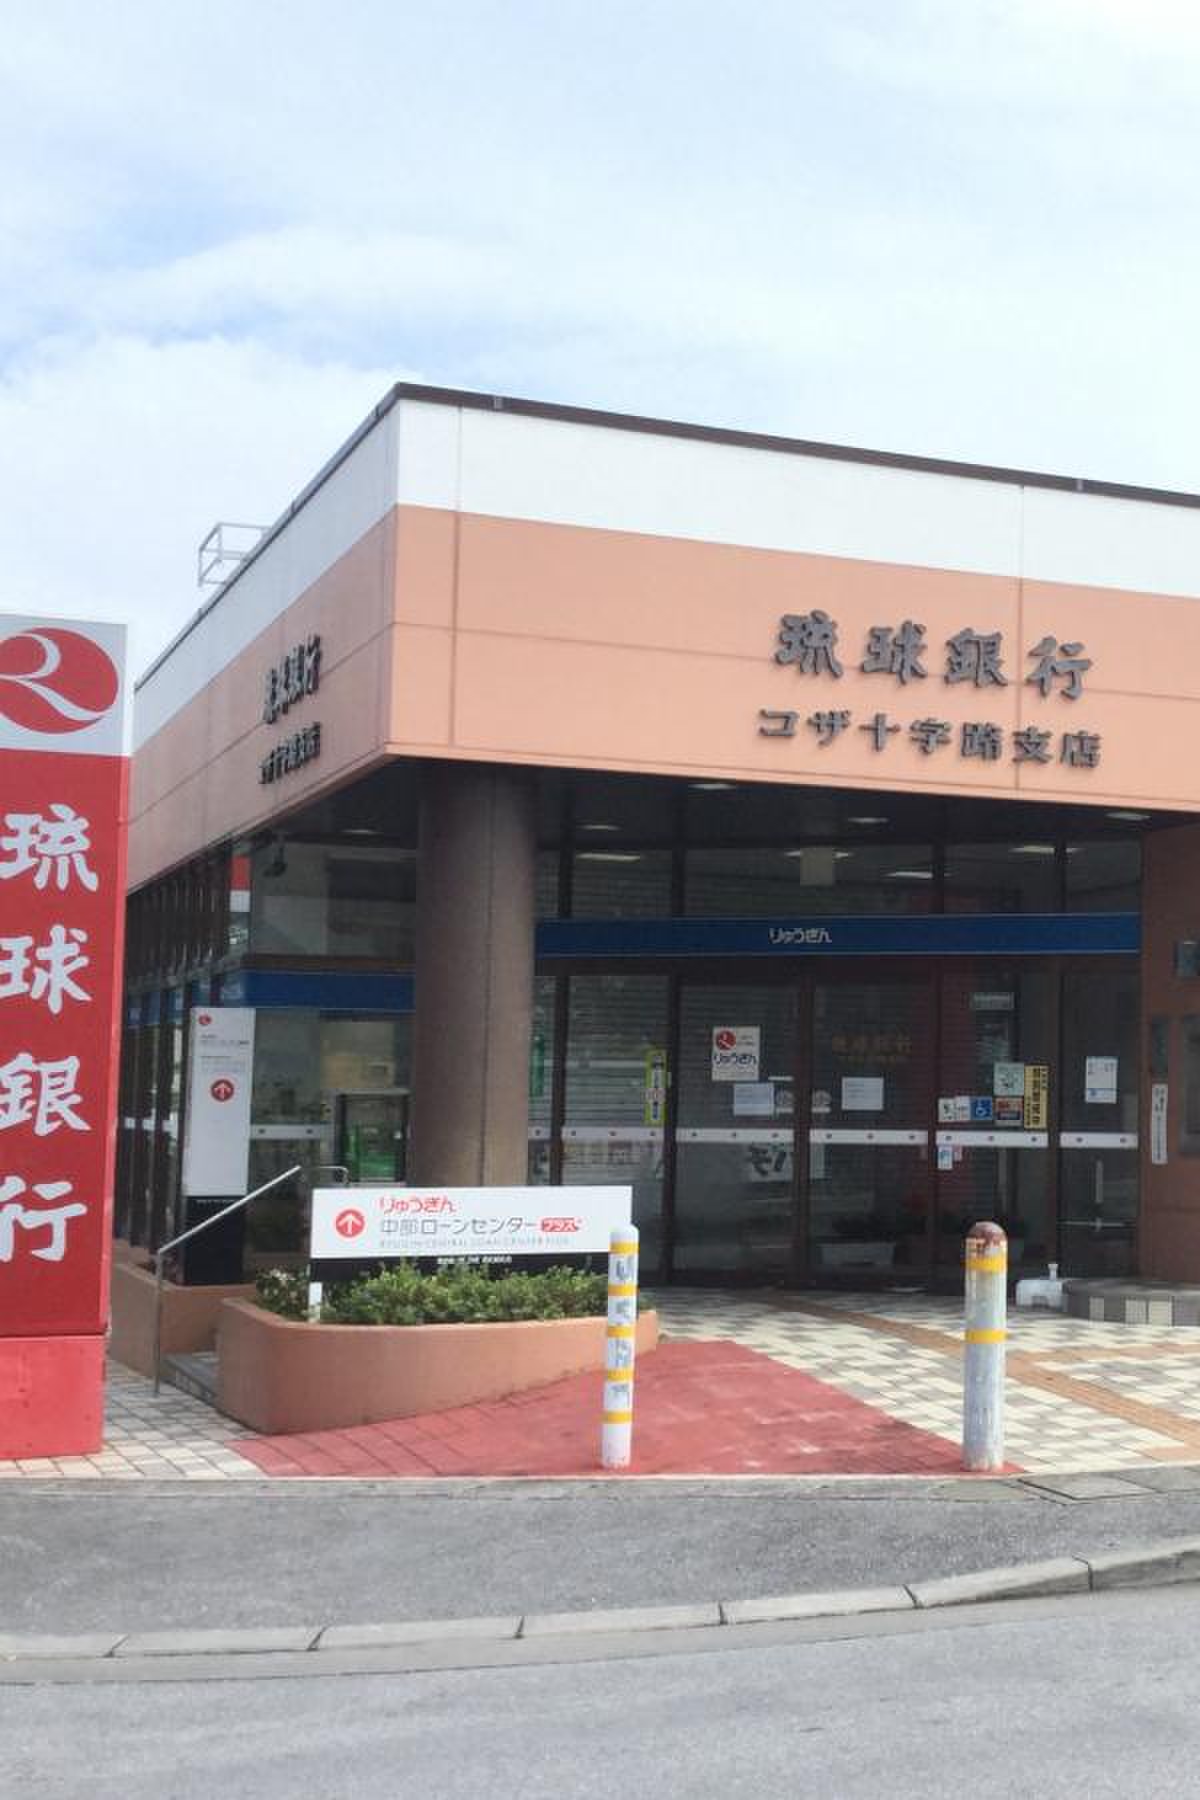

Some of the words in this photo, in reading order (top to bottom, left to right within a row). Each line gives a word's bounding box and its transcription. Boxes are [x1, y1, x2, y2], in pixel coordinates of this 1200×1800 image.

[774, 609, 1092, 701] 琉球銀行
[757, 708, 1102, 769] コザ十字路支店
[768, 926, 833, 945] りゅうぎん
[0, 803, 98, 1262] 琉球銀行
[379, 1196, 458, 1214] りゅうぎん
